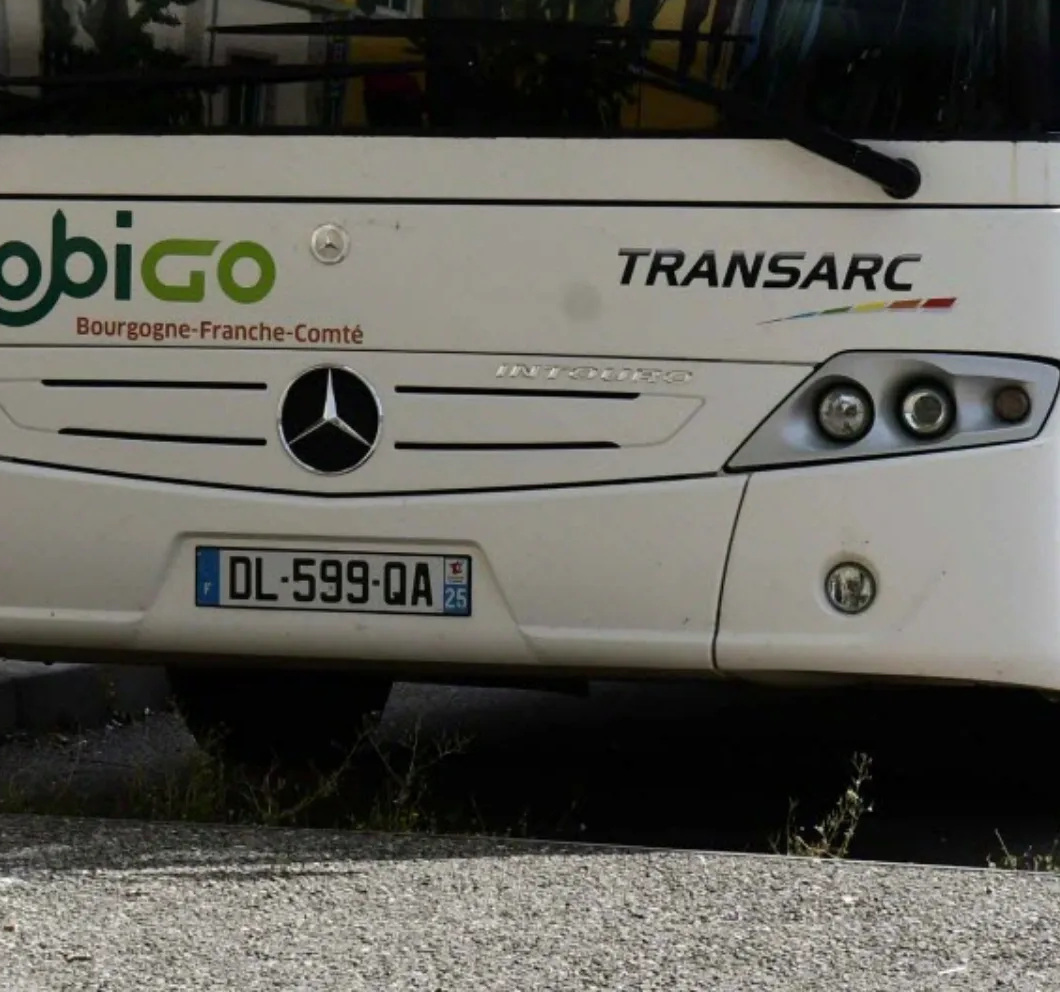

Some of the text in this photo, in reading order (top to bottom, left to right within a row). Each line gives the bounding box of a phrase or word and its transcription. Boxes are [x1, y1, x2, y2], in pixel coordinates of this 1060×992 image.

[617, 247, 923, 292] TRANSARC
[76, 316, 364, 345] Bourgogne-Franche-Comté
[495, 362, 693, 384] INTOURO
[228, 555, 434, 608] DL-599-QA
[444, 587, 468, 609] 25
